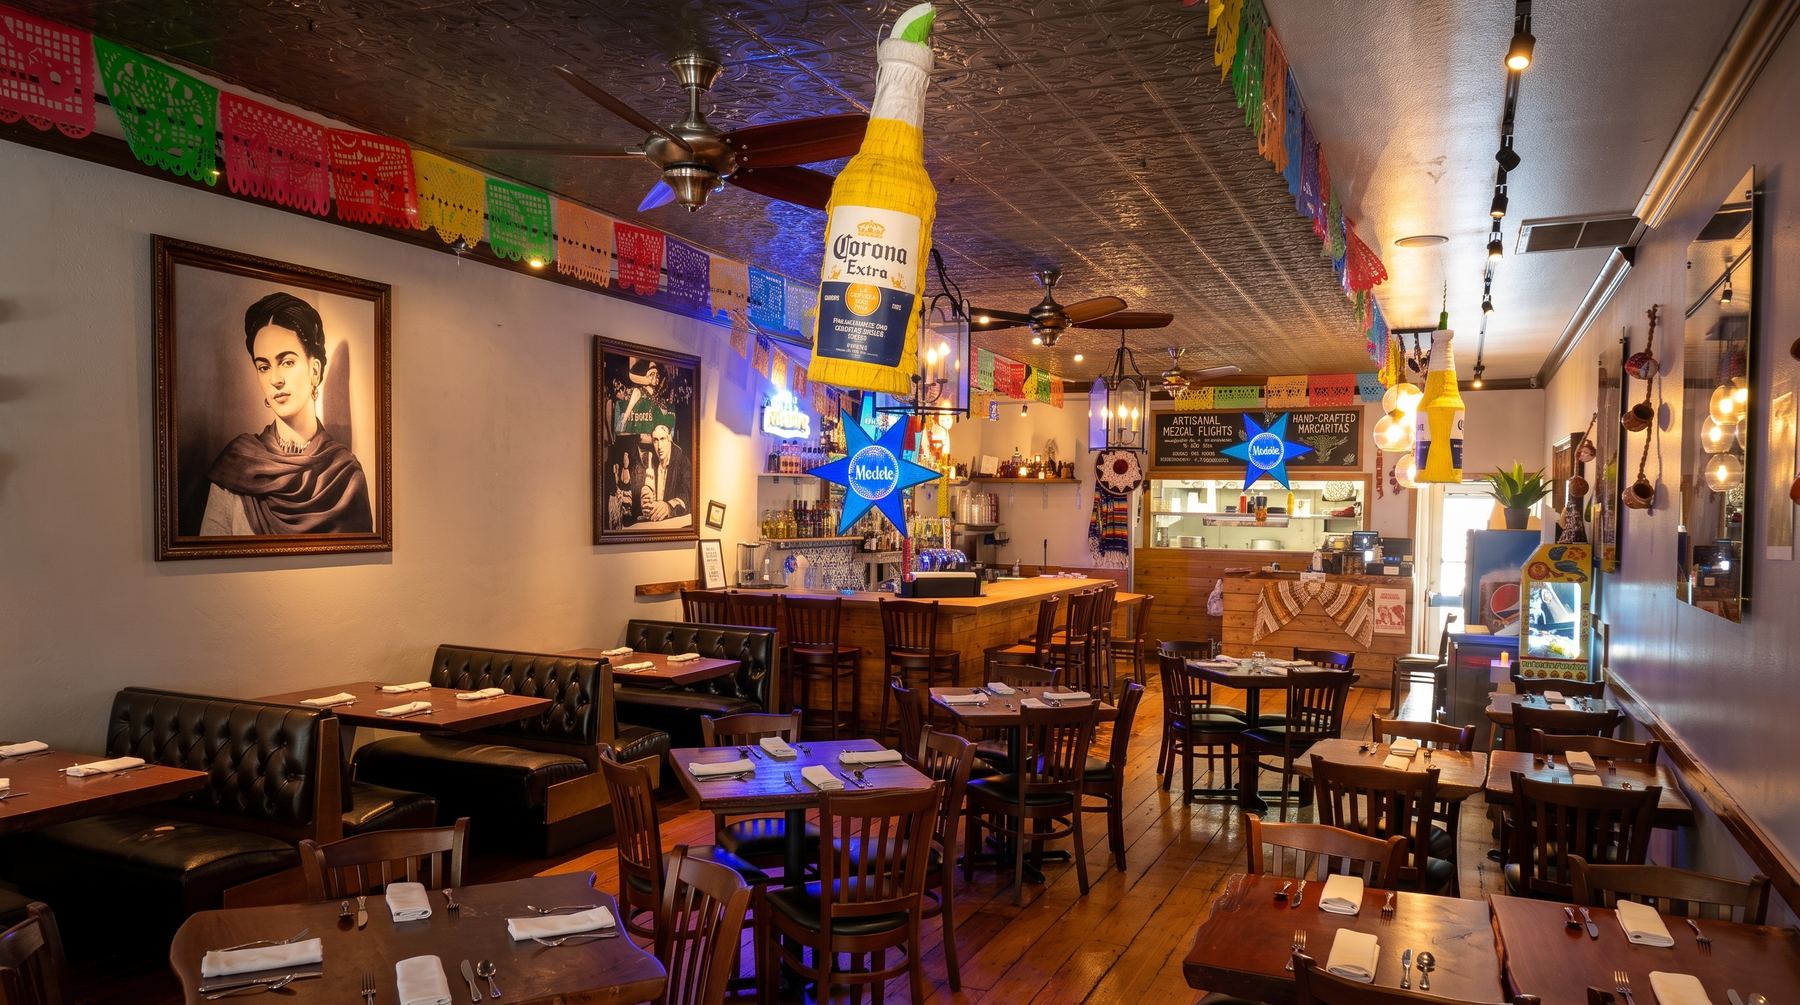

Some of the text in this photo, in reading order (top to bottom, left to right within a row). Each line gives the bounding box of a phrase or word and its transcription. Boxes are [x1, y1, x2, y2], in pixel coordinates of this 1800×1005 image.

[833, 233, 908, 265] Corona
[846, 259, 888, 280] Extra
[1172, 415, 1221, 425] ARTISANAL
[1292, 413, 1356, 423] HAND-CRAFTED
[1162, 425, 1233, 437] MEZCAL FLIGHTS
